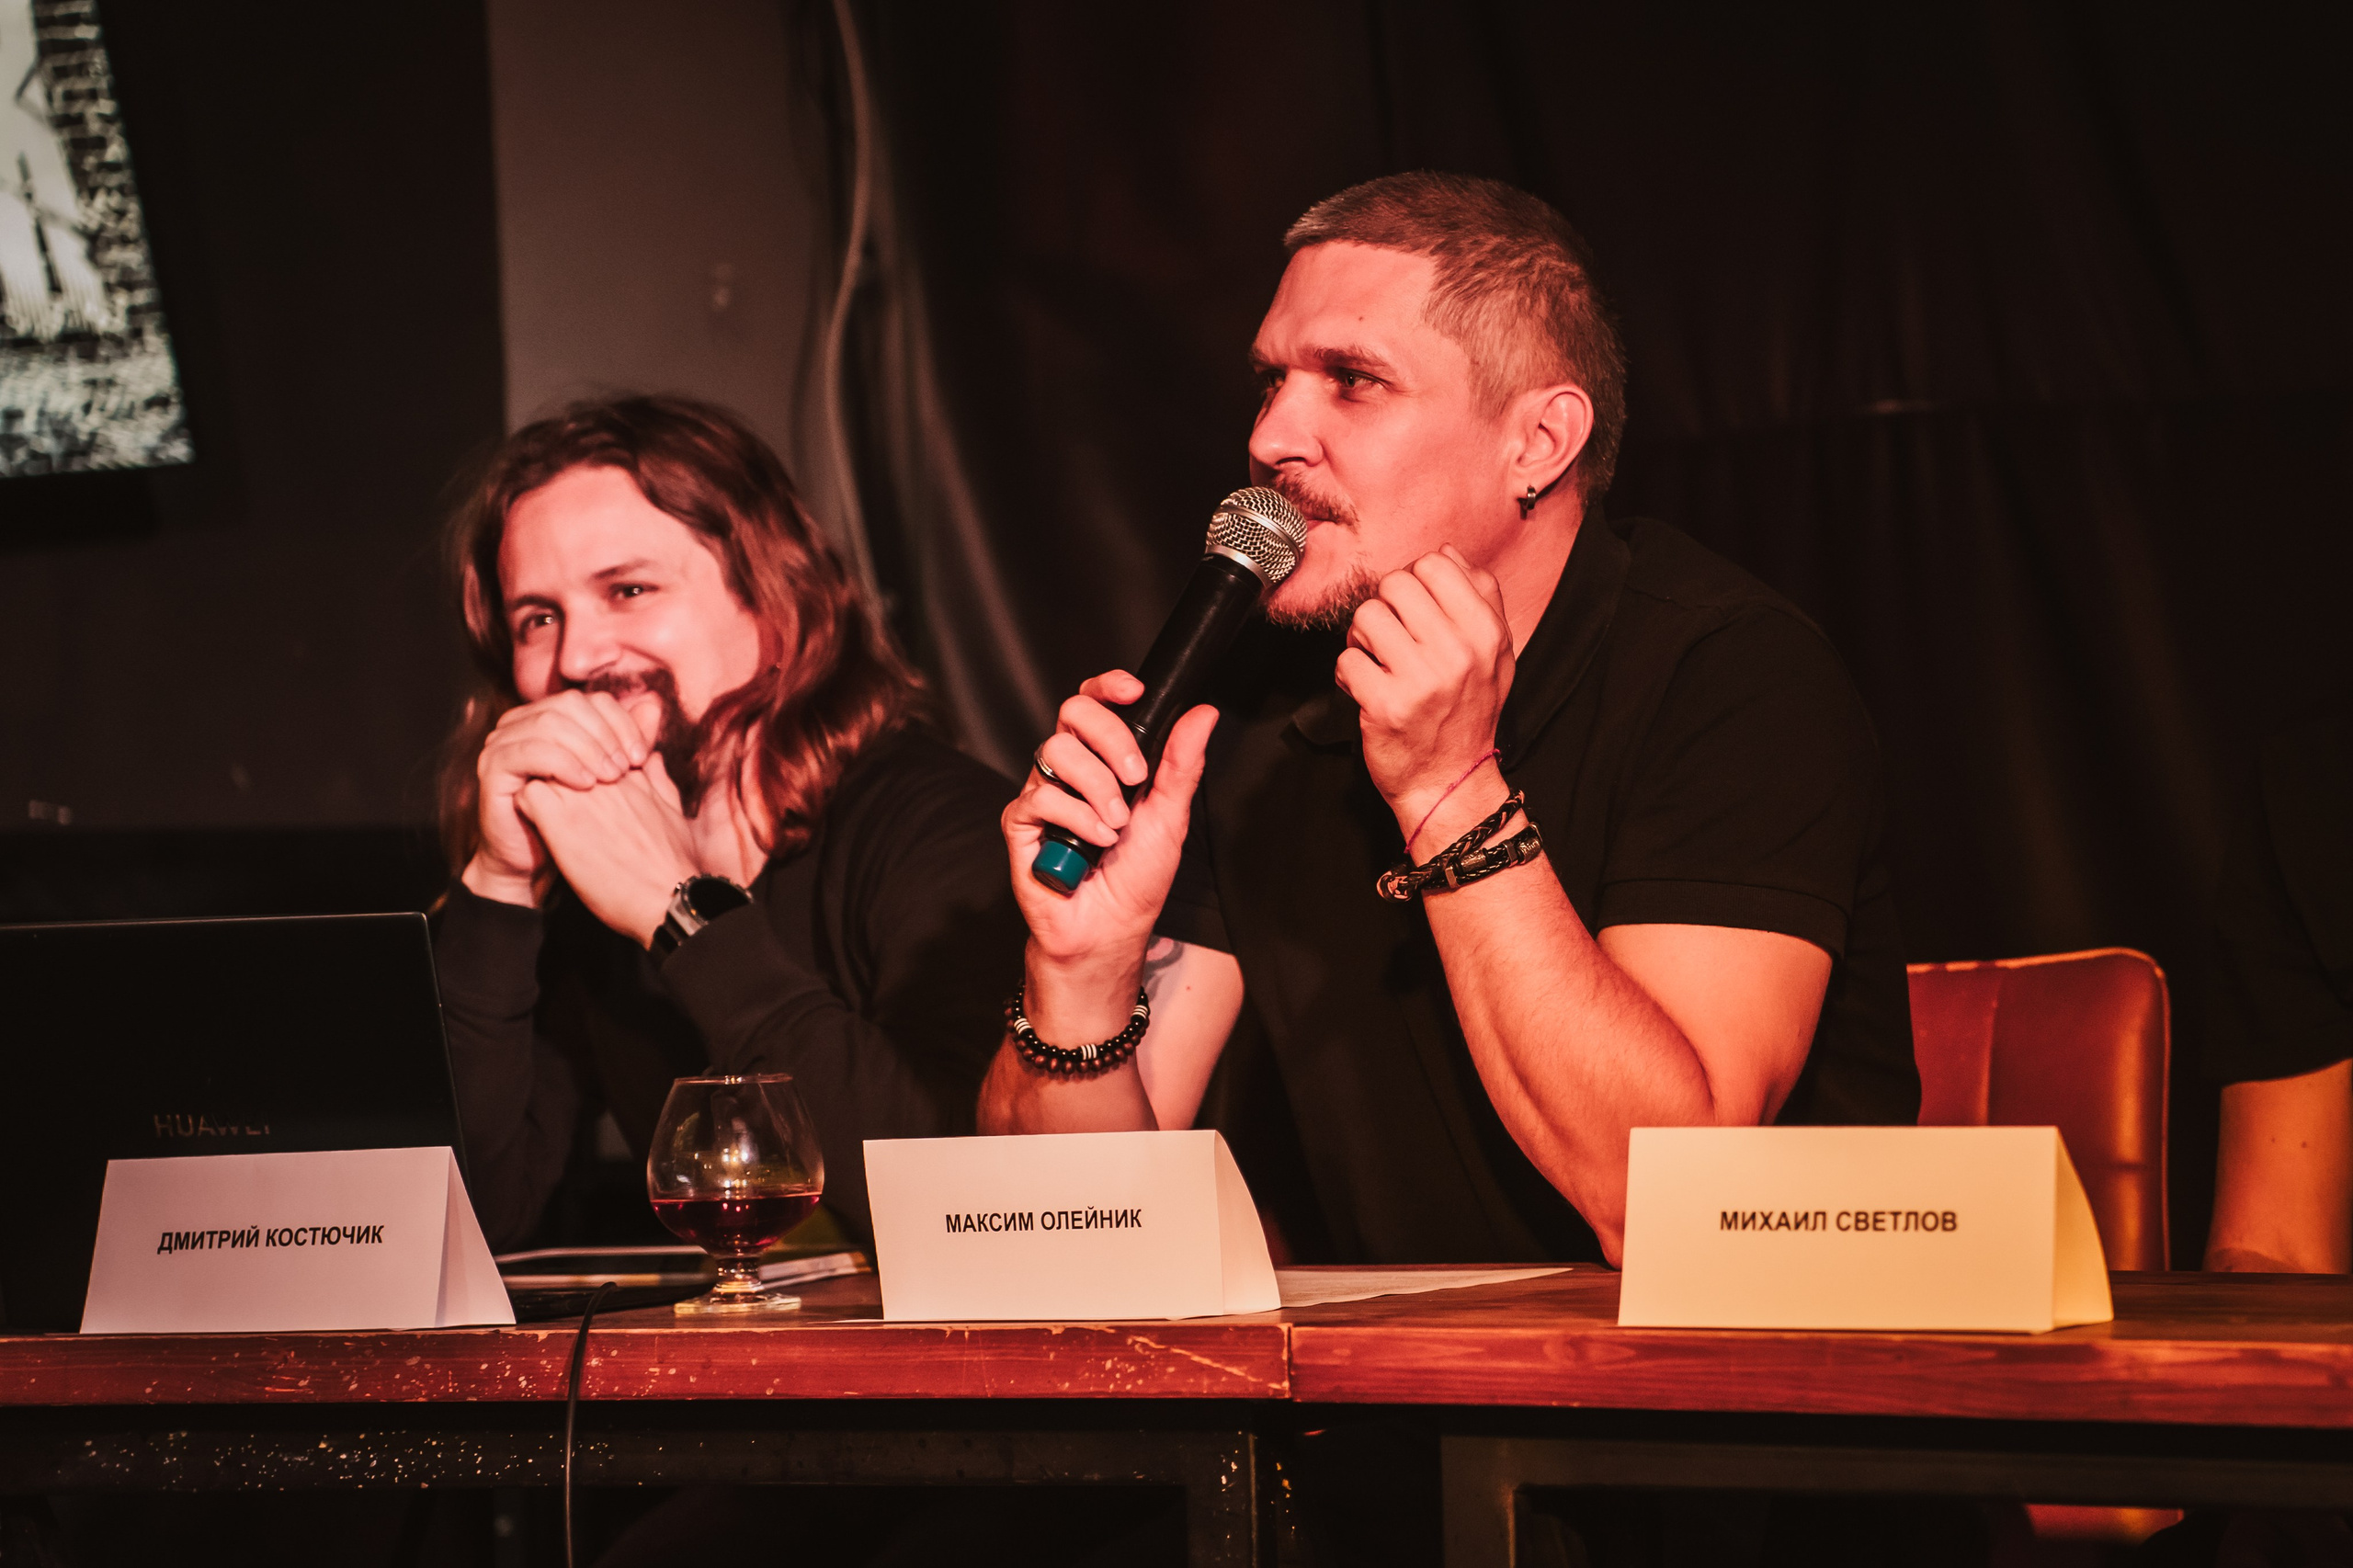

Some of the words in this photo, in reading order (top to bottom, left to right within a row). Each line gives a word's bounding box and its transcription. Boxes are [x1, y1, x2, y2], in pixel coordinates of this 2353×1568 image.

[945, 1212, 1034, 1233] МАКСИМ
[1040, 1206, 1142, 1230] ОЛЕЙНИК
[1720, 1210, 1827, 1232] МИХАИЛ
[1836, 1210, 1958, 1232] СВЕТЛОВ
[157, 1226, 259, 1255] ДМИТРИЙ
[266, 1225, 385, 1247] КОСТЮЧИК
